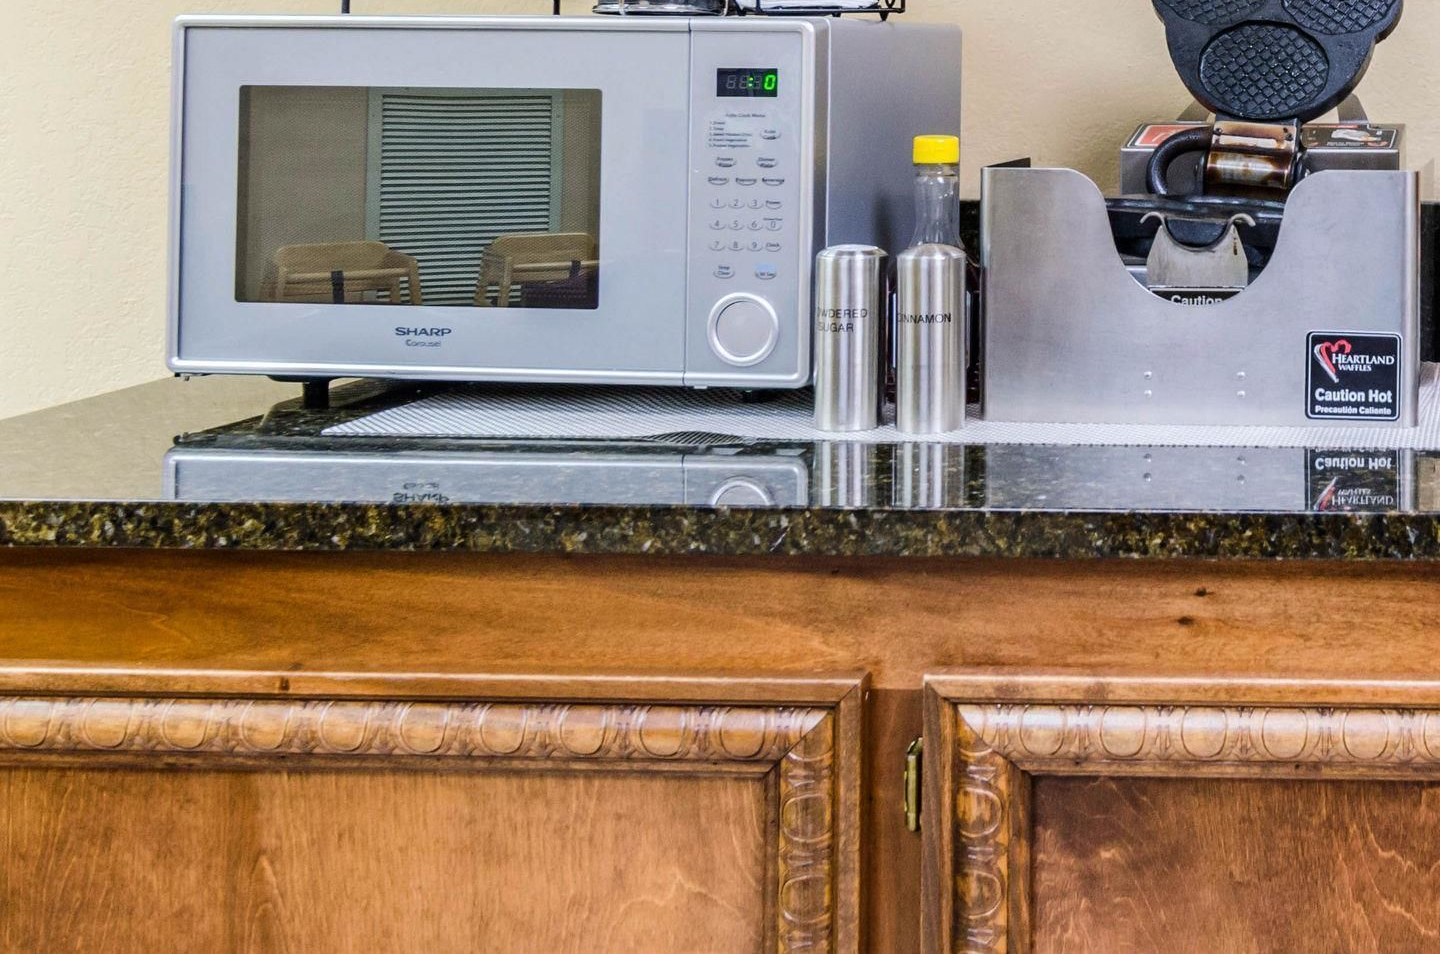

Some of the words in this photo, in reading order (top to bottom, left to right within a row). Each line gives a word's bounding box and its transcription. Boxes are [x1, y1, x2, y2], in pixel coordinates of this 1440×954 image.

[898, 312, 951, 324] CINNAMON
[395, 327, 452, 336] SHARP
[819, 322, 854, 333] SUGAR
[1332, 353, 1395, 365] HEARTLAND
[1338, 364, 1372, 372] WAFFLES
[1314, 388, 1366, 402] Caution
[1368, 389, 1393, 403] Hot
[1359, 406, 1392, 415] Caliente
